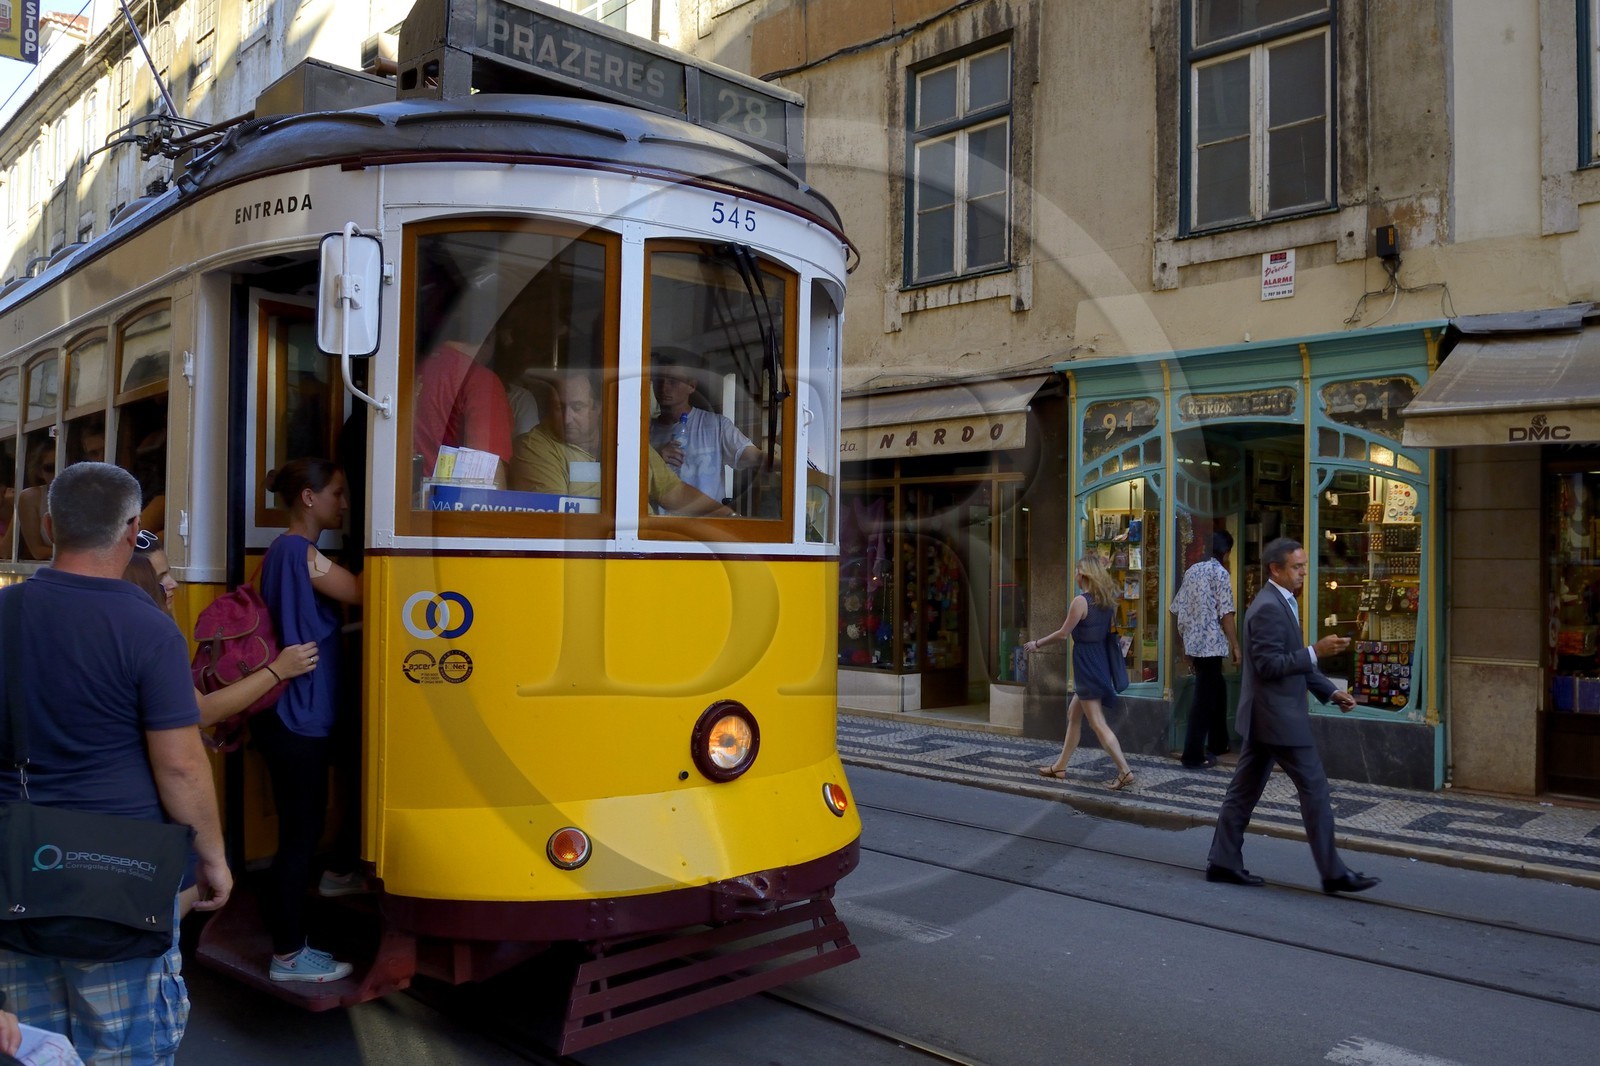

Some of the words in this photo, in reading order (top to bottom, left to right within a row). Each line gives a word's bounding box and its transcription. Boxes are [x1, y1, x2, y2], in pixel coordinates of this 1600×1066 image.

[25, 1, 37, 55] STOP
[487, 15, 665, 98] PRAZERES
[717, 88, 768, 138] 28
[235, 193, 313, 225] ENTRADA
[711, 201, 756, 232] 545
[1263, 276, 1293, 286] ALARME
[1354, 391, 1390, 421] 91
[879, 423, 1004, 450] NARDO
[1102, 411, 1134, 441] 91
[1508, 425, 1572, 442] DMC
[432, 500, 452, 511] VIA
[471, 503, 554, 513] CAVALE
[66, 852, 157, 874] DROSSBACH
